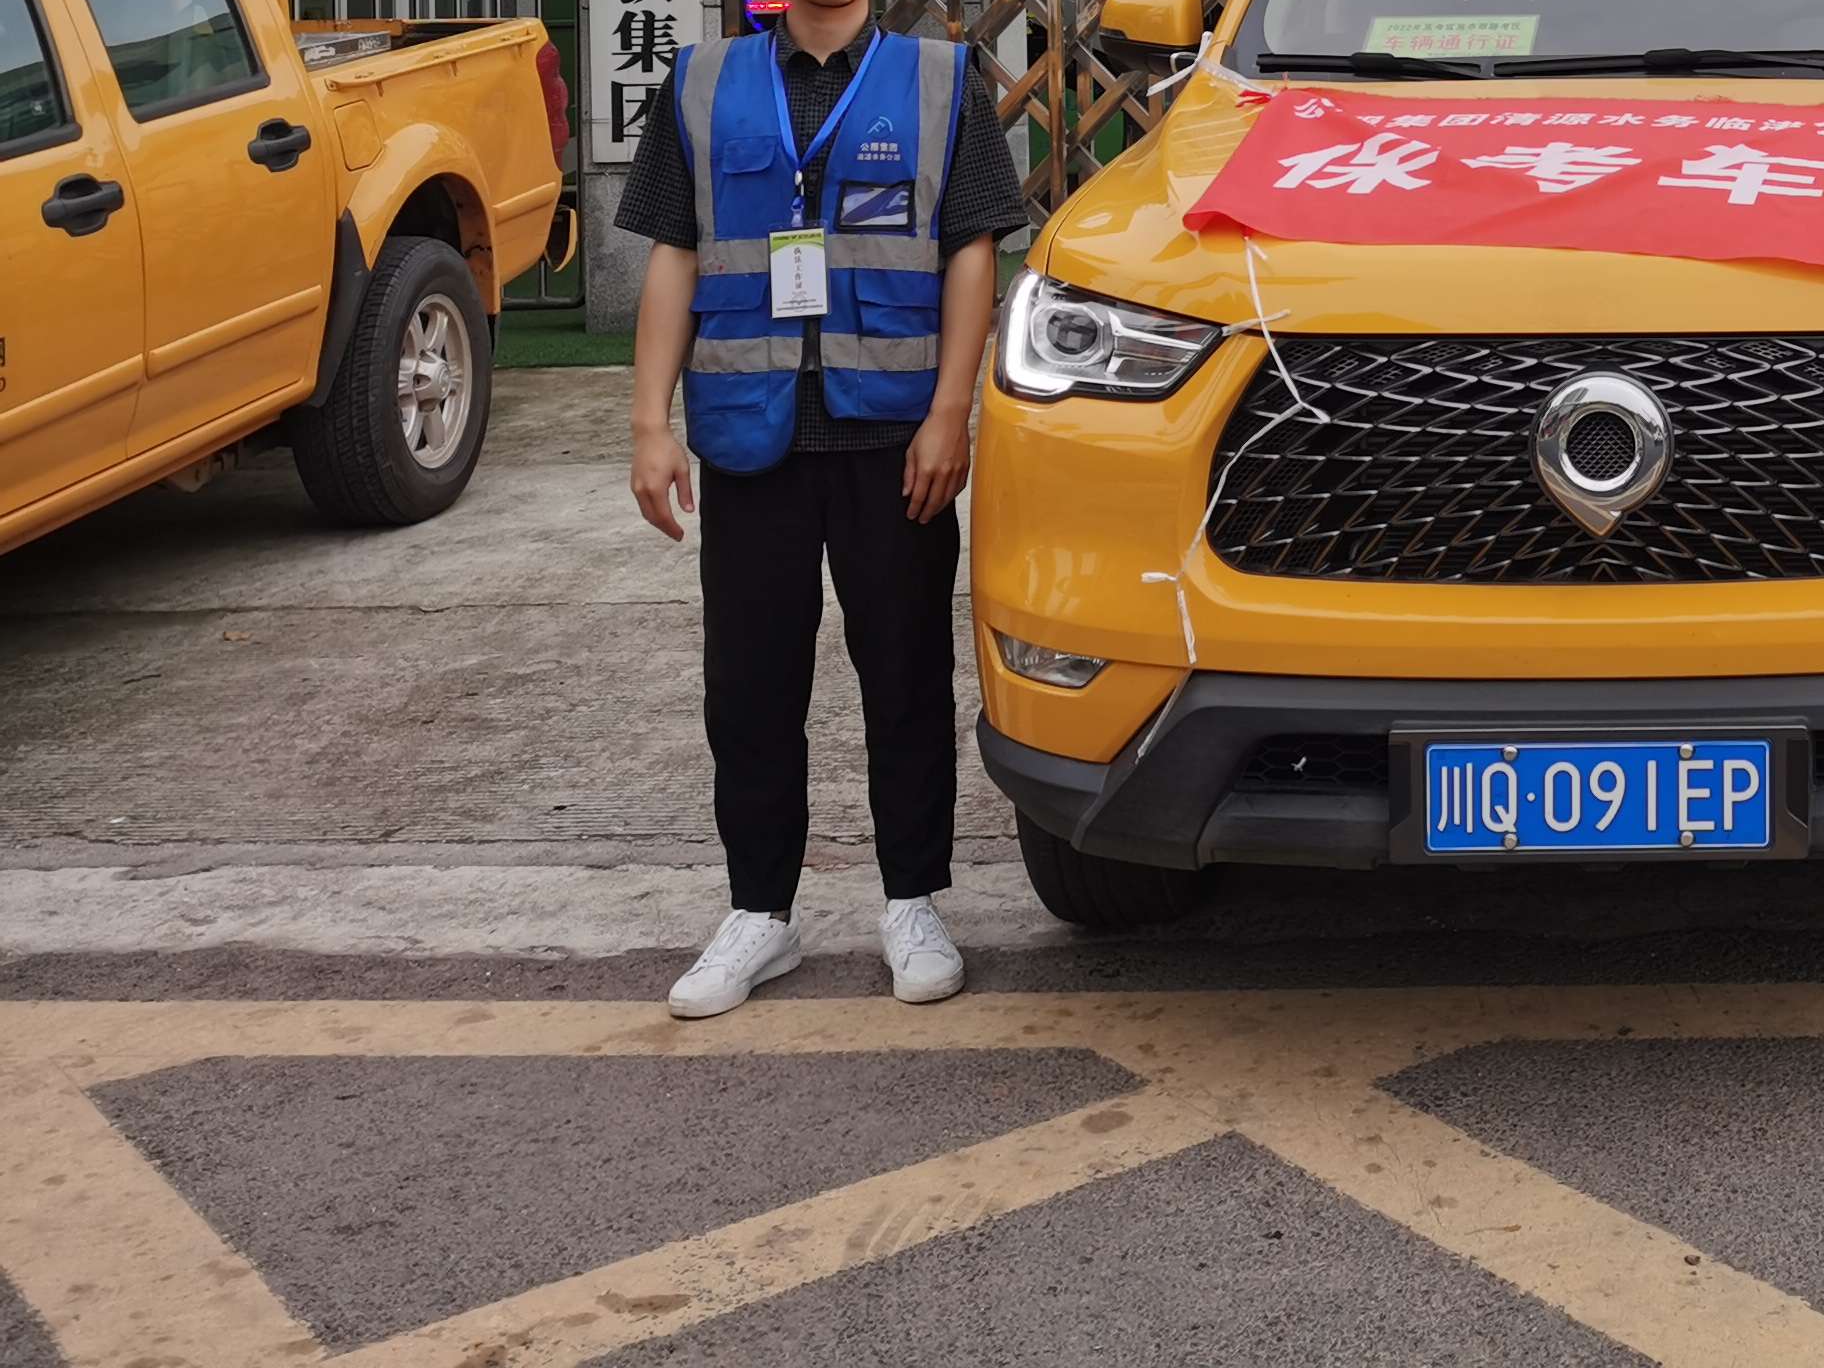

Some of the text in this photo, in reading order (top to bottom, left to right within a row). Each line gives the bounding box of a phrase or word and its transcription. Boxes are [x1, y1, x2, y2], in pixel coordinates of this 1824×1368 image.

[1384, 34, 1520, 51] 车辆通行证
